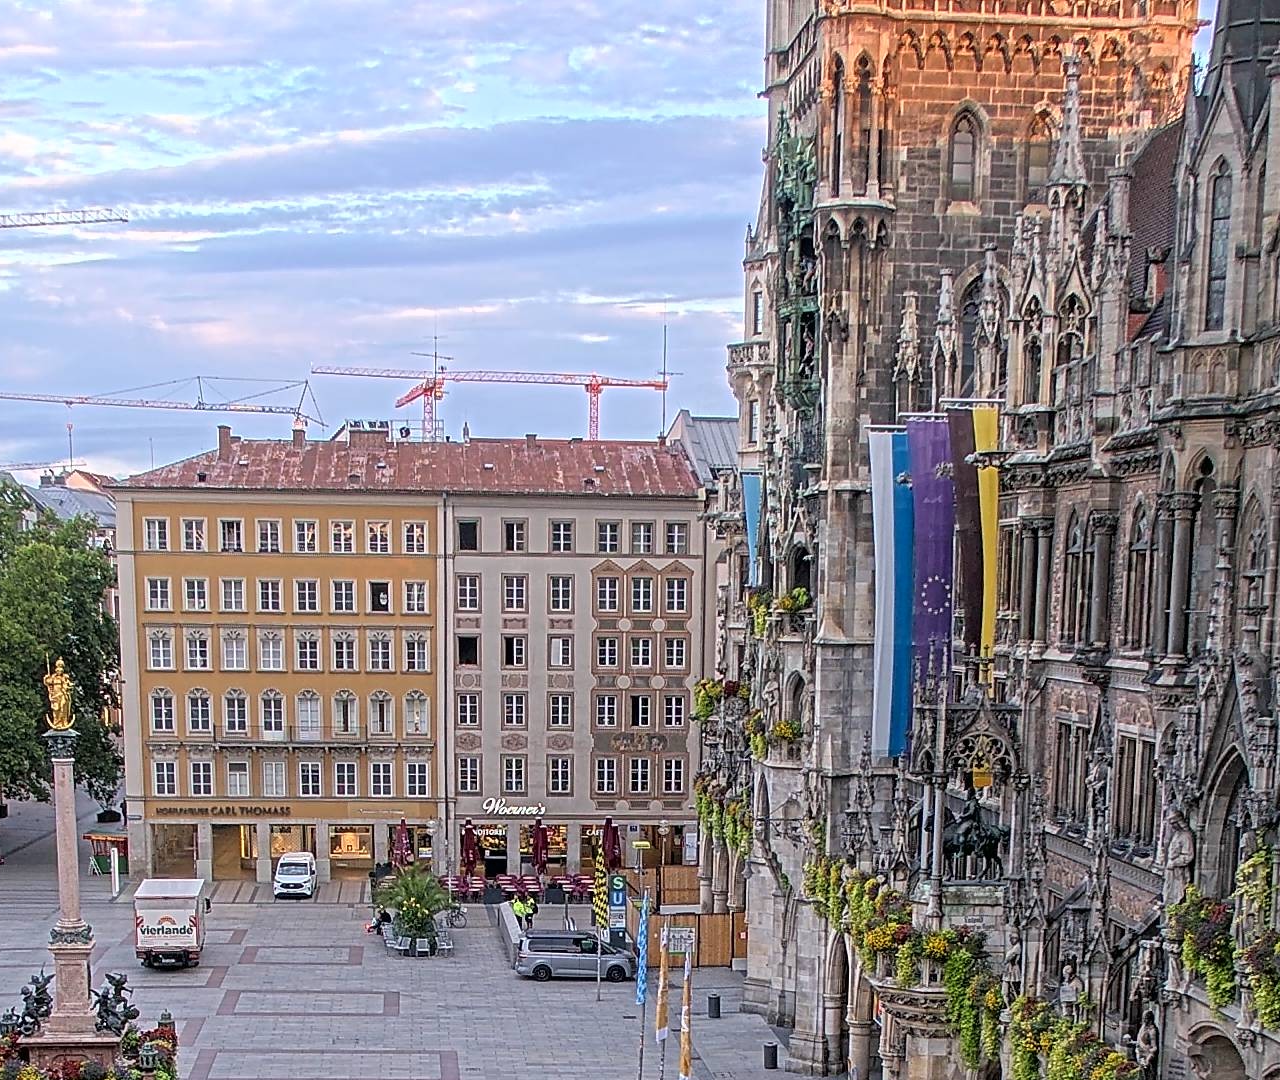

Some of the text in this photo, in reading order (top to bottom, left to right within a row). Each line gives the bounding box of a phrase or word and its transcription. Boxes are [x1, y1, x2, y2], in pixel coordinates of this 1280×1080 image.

[211, 806, 237, 816] CARL
[239, 806, 291, 816] THOMASS
[613, 877, 624, 889] S
[613, 893, 623, 904] U
[140, 926, 193, 935] vierlande
